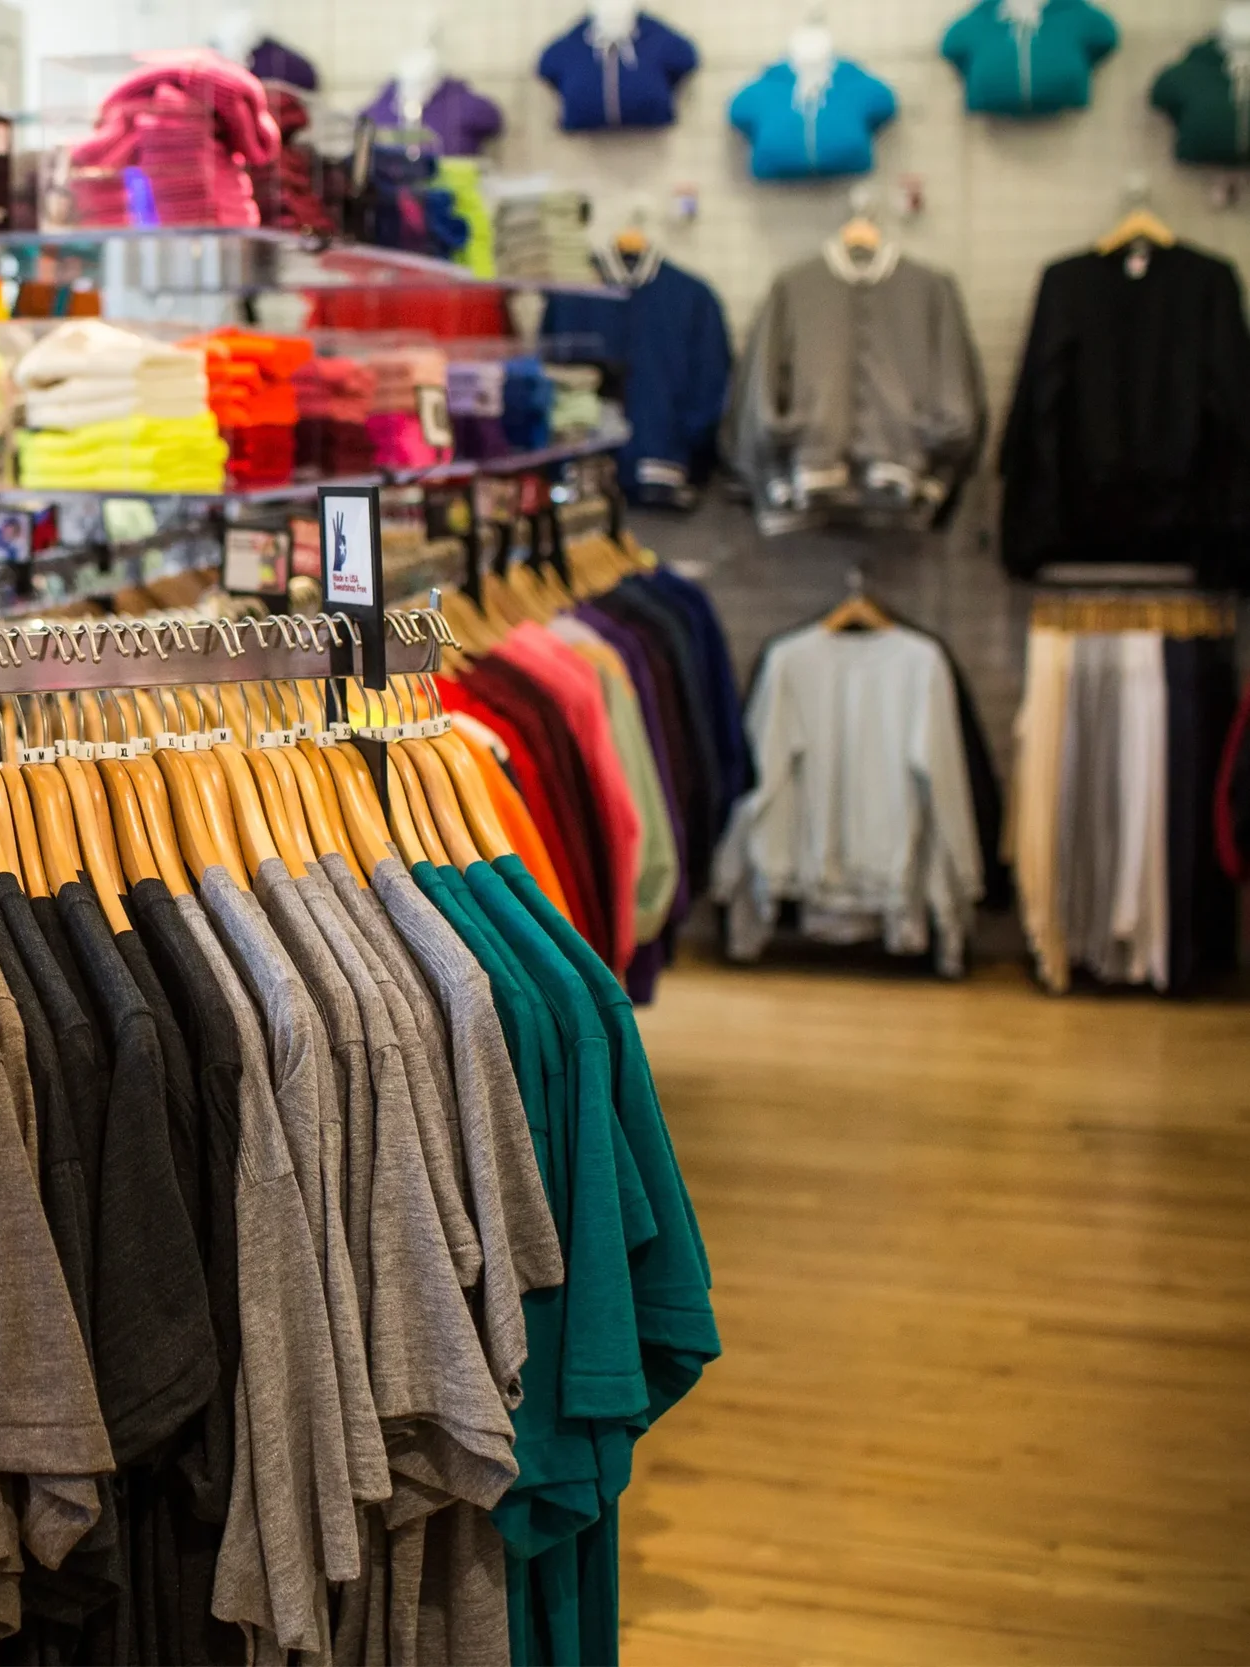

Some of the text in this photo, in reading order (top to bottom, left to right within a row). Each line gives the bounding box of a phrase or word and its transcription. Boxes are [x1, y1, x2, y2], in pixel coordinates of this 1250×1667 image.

[350, 574, 359, 583] USA
[333, 582, 367, 594] Sweatshop Free
[220, 731, 227, 741] M
[24, 753, 31, 763] M
[38, 751, 45, 760] M
